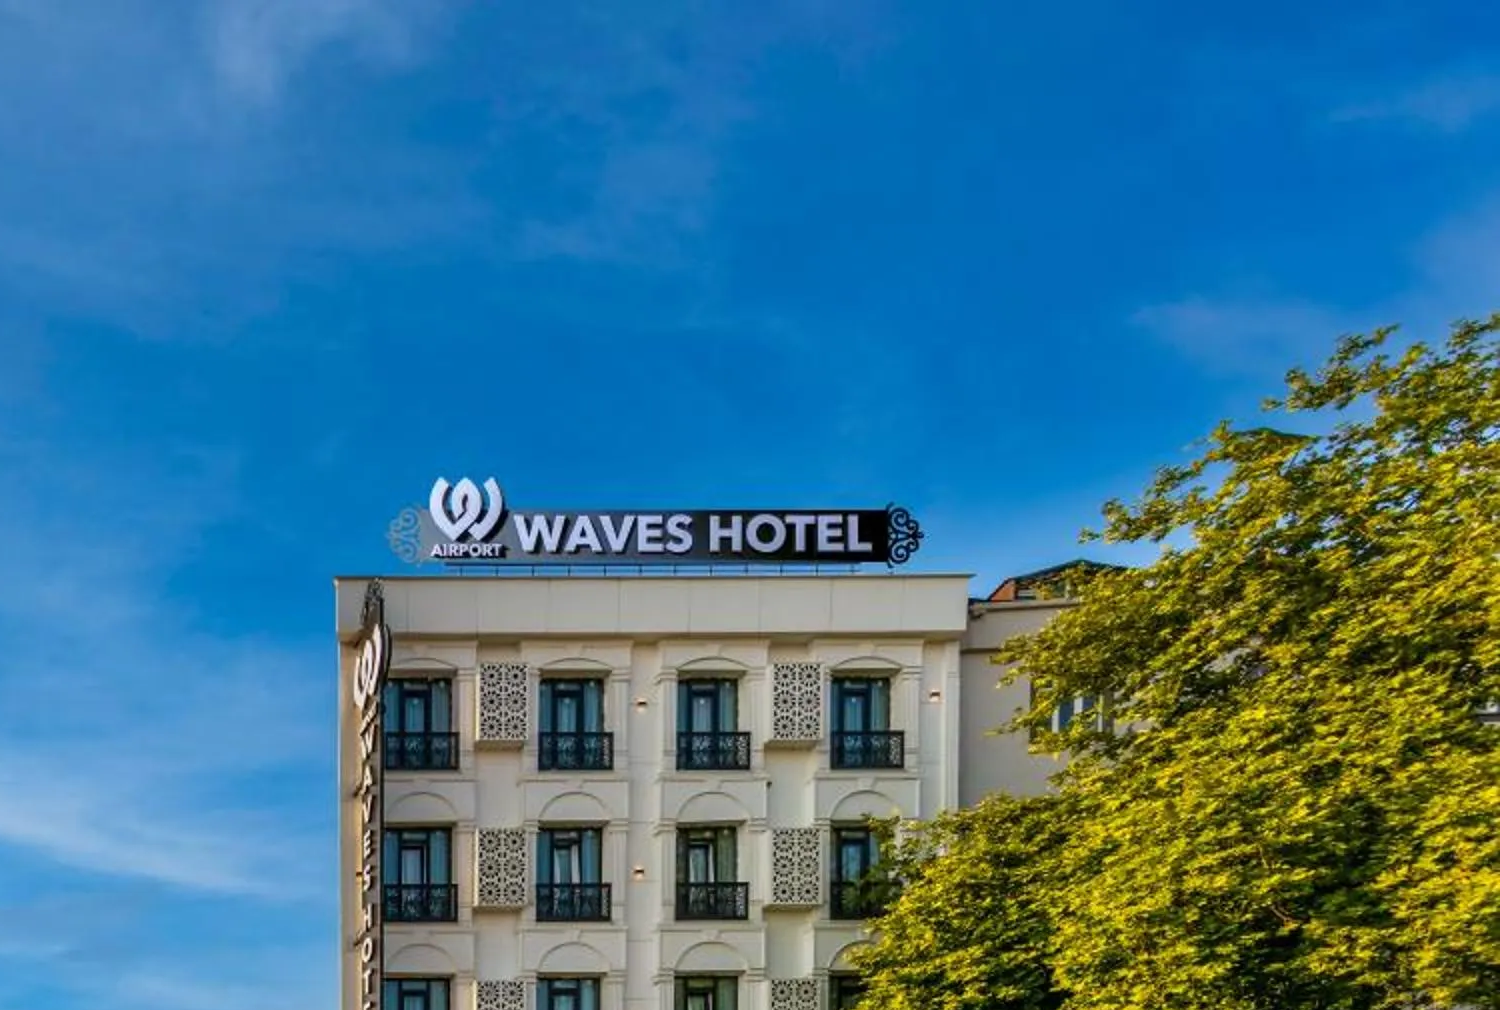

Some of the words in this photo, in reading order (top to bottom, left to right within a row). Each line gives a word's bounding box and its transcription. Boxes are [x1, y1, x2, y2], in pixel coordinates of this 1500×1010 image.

[430, 543, 502, 558] AIRPORT
[513, 513, 693, 554] WAVES
[709, 513, 873, 554] HOTEL
[361, 723, 376, 892] WAVES
